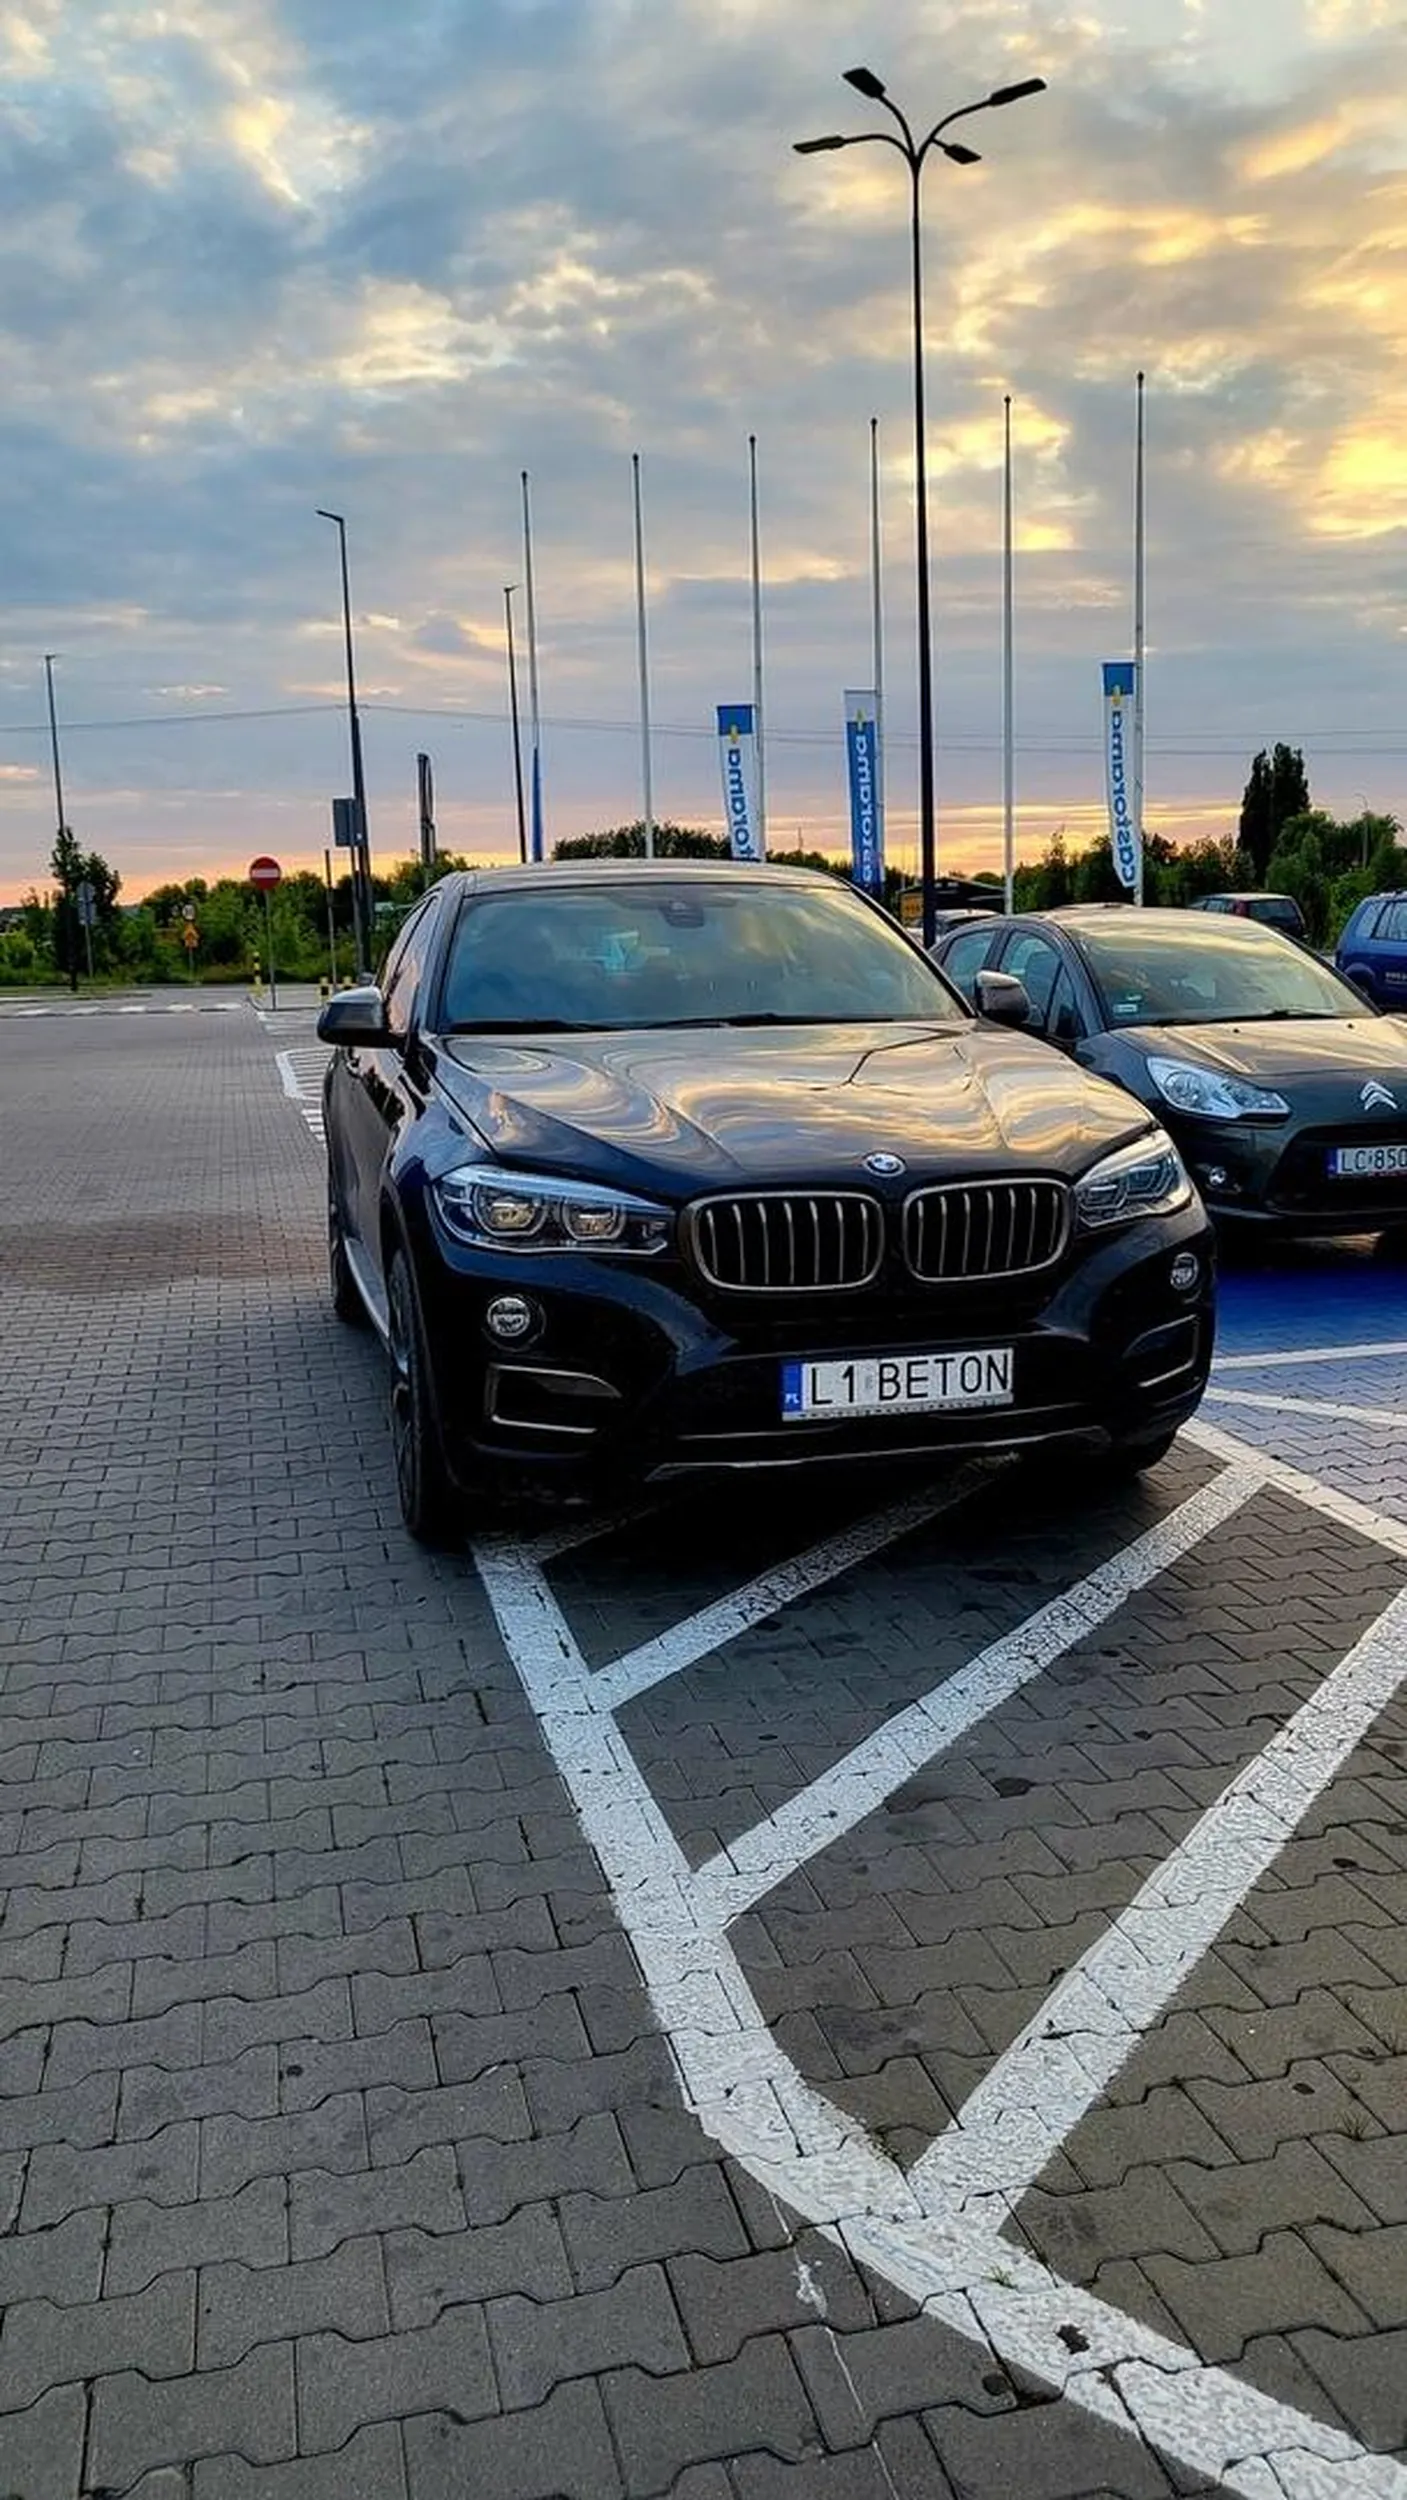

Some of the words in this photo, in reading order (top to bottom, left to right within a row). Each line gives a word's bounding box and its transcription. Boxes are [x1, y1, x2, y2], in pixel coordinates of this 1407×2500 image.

[1341, 1149, 1366, 1171] LC
[811, 1364, 854, 1405] L1
[879, 1353, 1008, 1401] BETON
